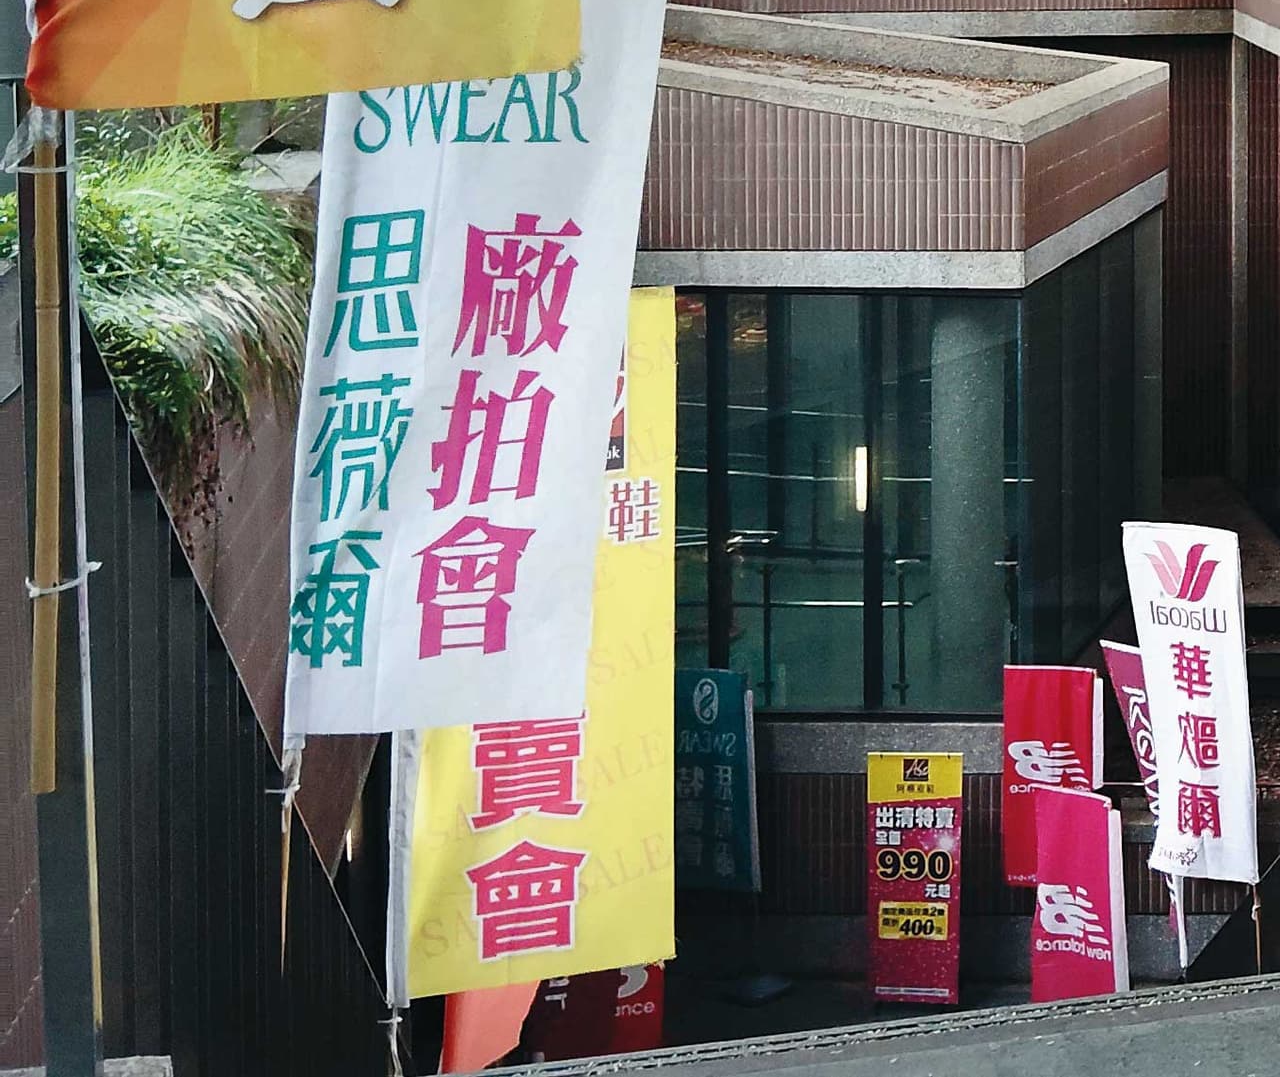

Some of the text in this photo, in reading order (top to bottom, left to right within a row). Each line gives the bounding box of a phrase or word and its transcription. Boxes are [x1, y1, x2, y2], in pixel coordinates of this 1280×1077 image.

[353, 66, 591, 154] SWEAR
[291, 208, 424, 669] 思薇爾
[416, 214, 583, 662] 廠拍會
[877, 848, 953, 882] 990
[899, 919, 935, 936] 400
